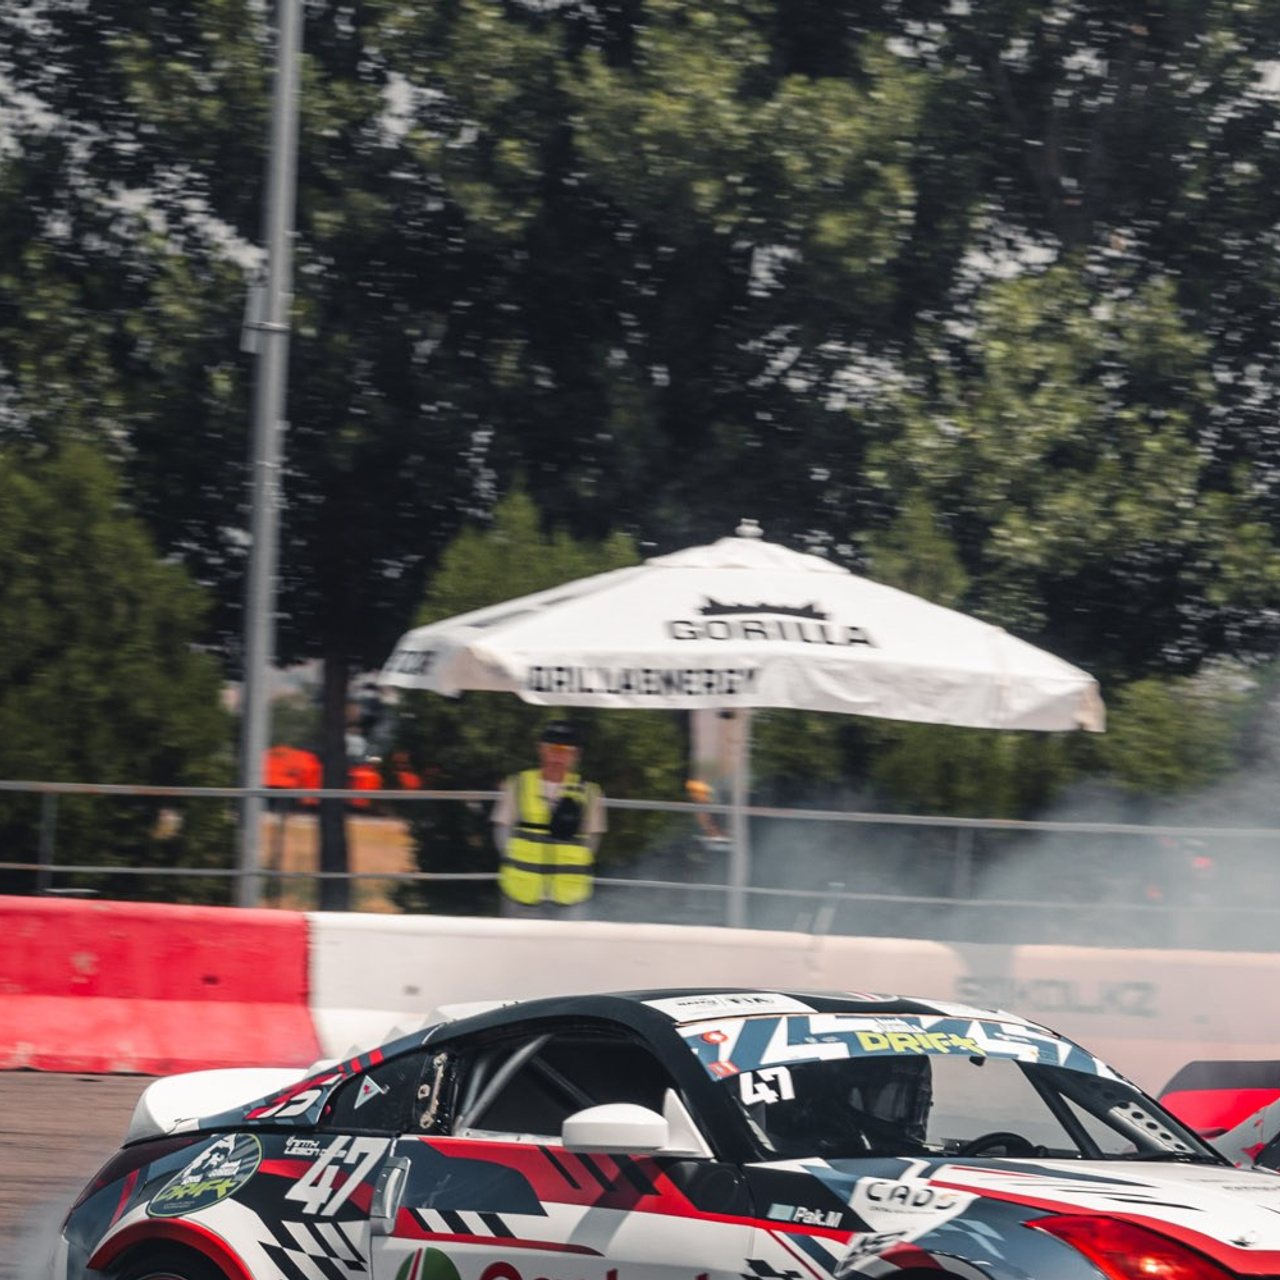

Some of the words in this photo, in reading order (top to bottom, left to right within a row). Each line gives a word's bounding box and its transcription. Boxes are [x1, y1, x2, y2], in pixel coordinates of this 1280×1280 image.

[666, 620, 876, 649] GORILLA
[740, 1066, 796, 1106] 47
[285, 1135, 392, 1217] 47
